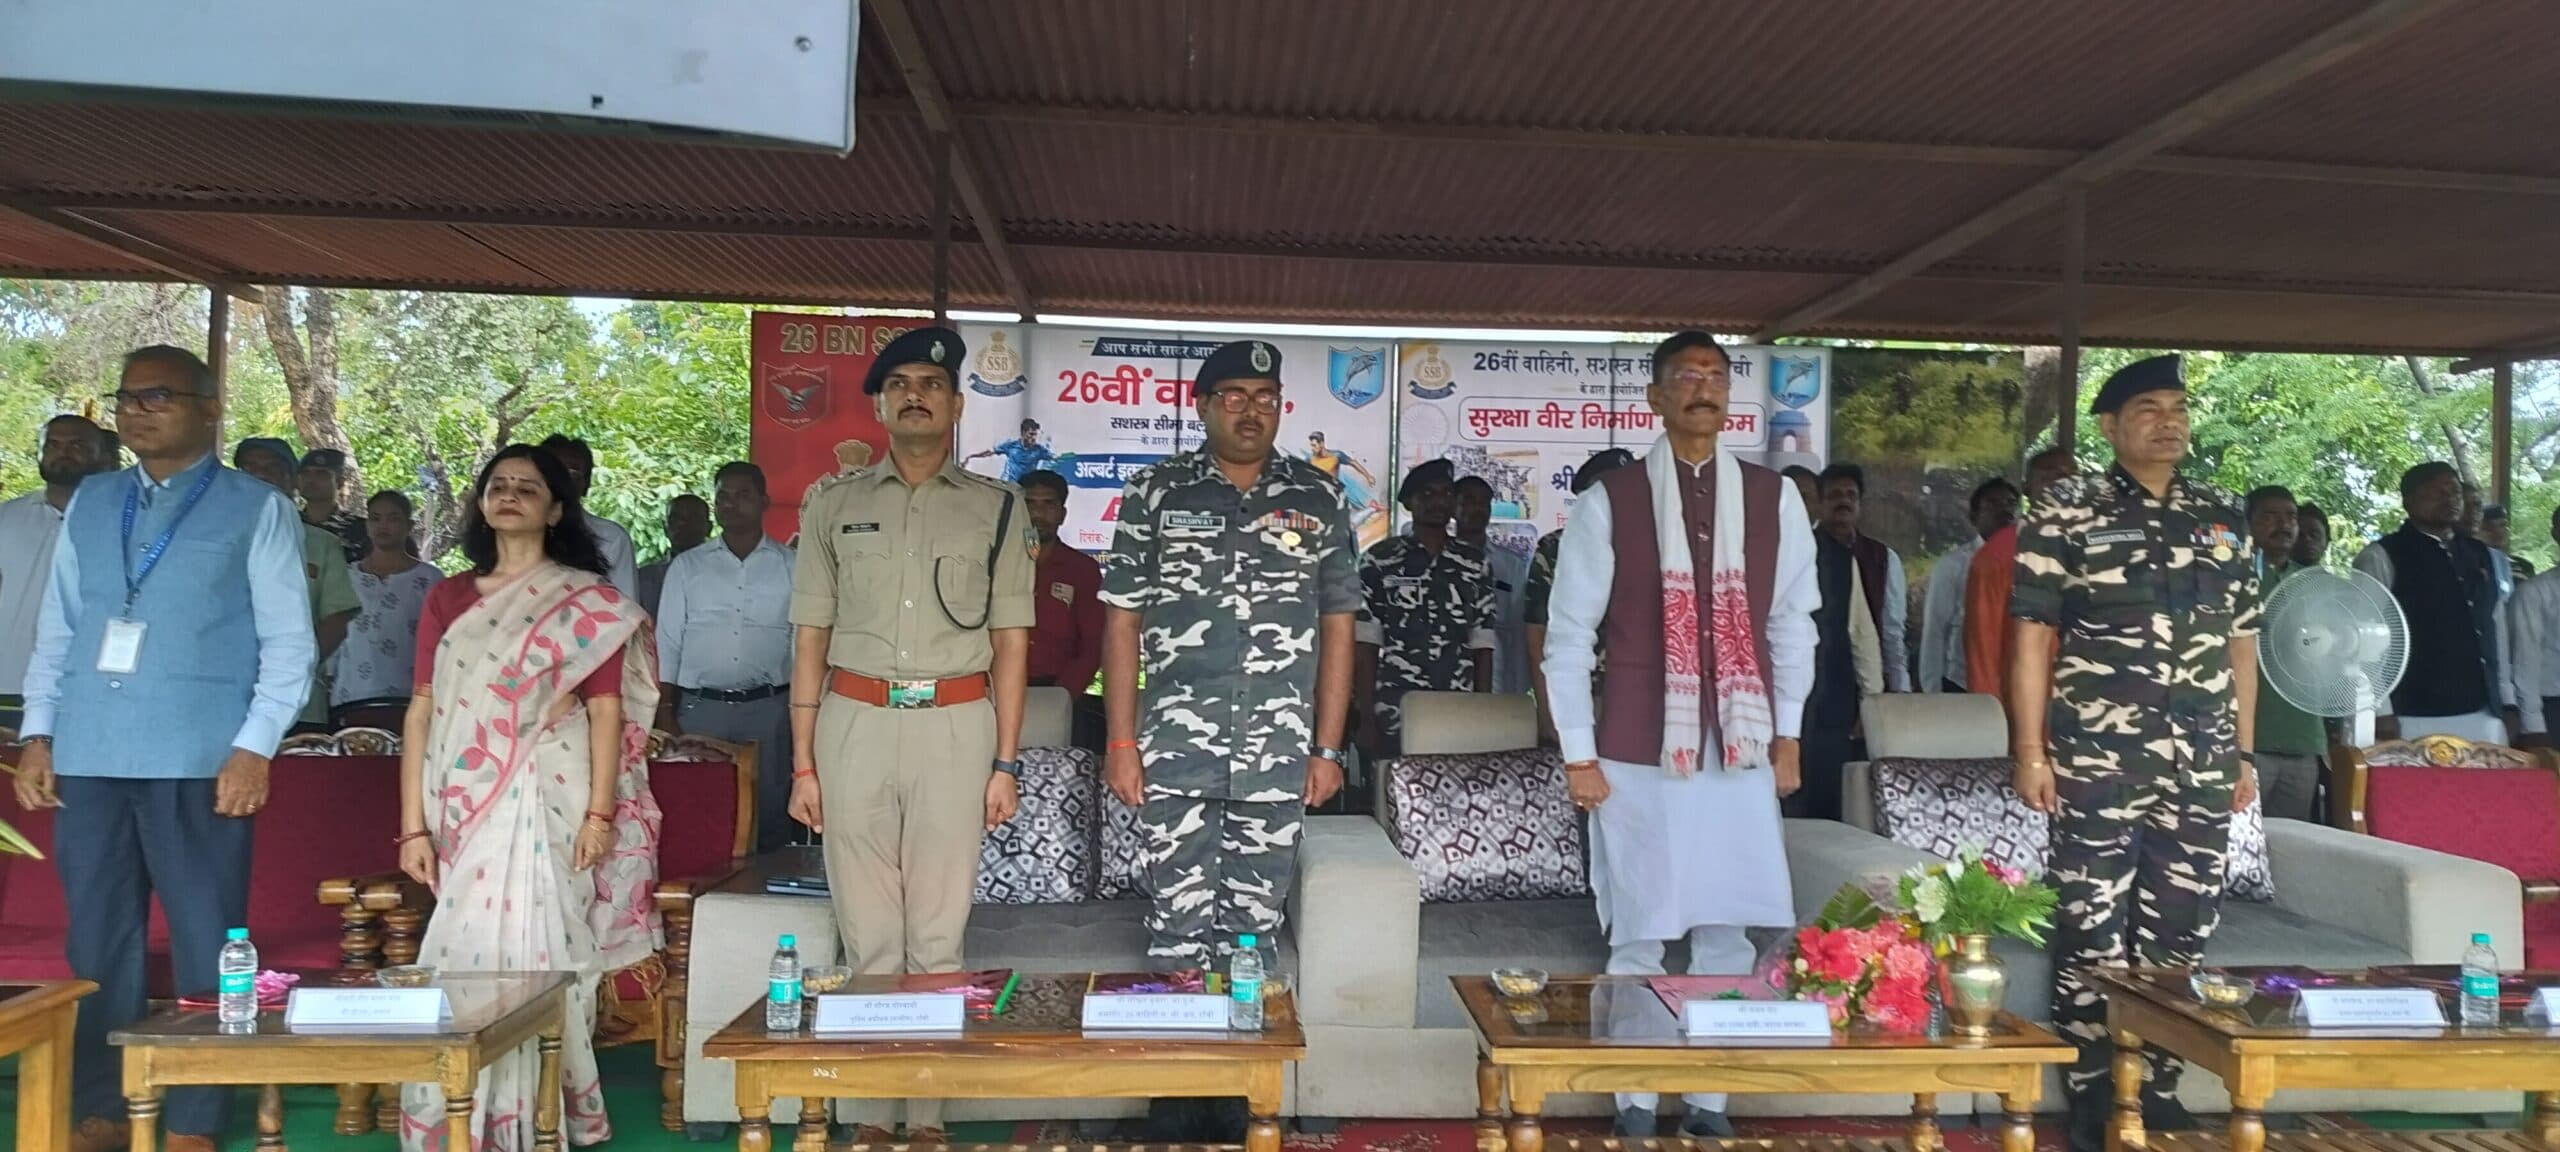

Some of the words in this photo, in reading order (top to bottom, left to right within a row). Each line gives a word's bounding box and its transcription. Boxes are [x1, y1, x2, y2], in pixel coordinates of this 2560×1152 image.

[780, 322, 817, 353] 26
[823, 325, 865, 355] BN
[1101, 342, 1127, 354] आप
[987, 356, 1009, 371] SSB
[1424, 366, 1442, 379] SSB
[1474, 350, 1519, 373] 26वीं
[1523, 350, 1579, 377] वाहिनी,
[1586, 357, 1634, 377] सशस्त्र
[1057, 364, 1153, 406] 26वीं
[1468, 408, 1530, 438] सुरक्षा
[1537, 402, 1576, 429] वीर
[1581, 403, 1655, 430] निर्माण
[1074, 456, 1115, 479] अल्बर्ट
